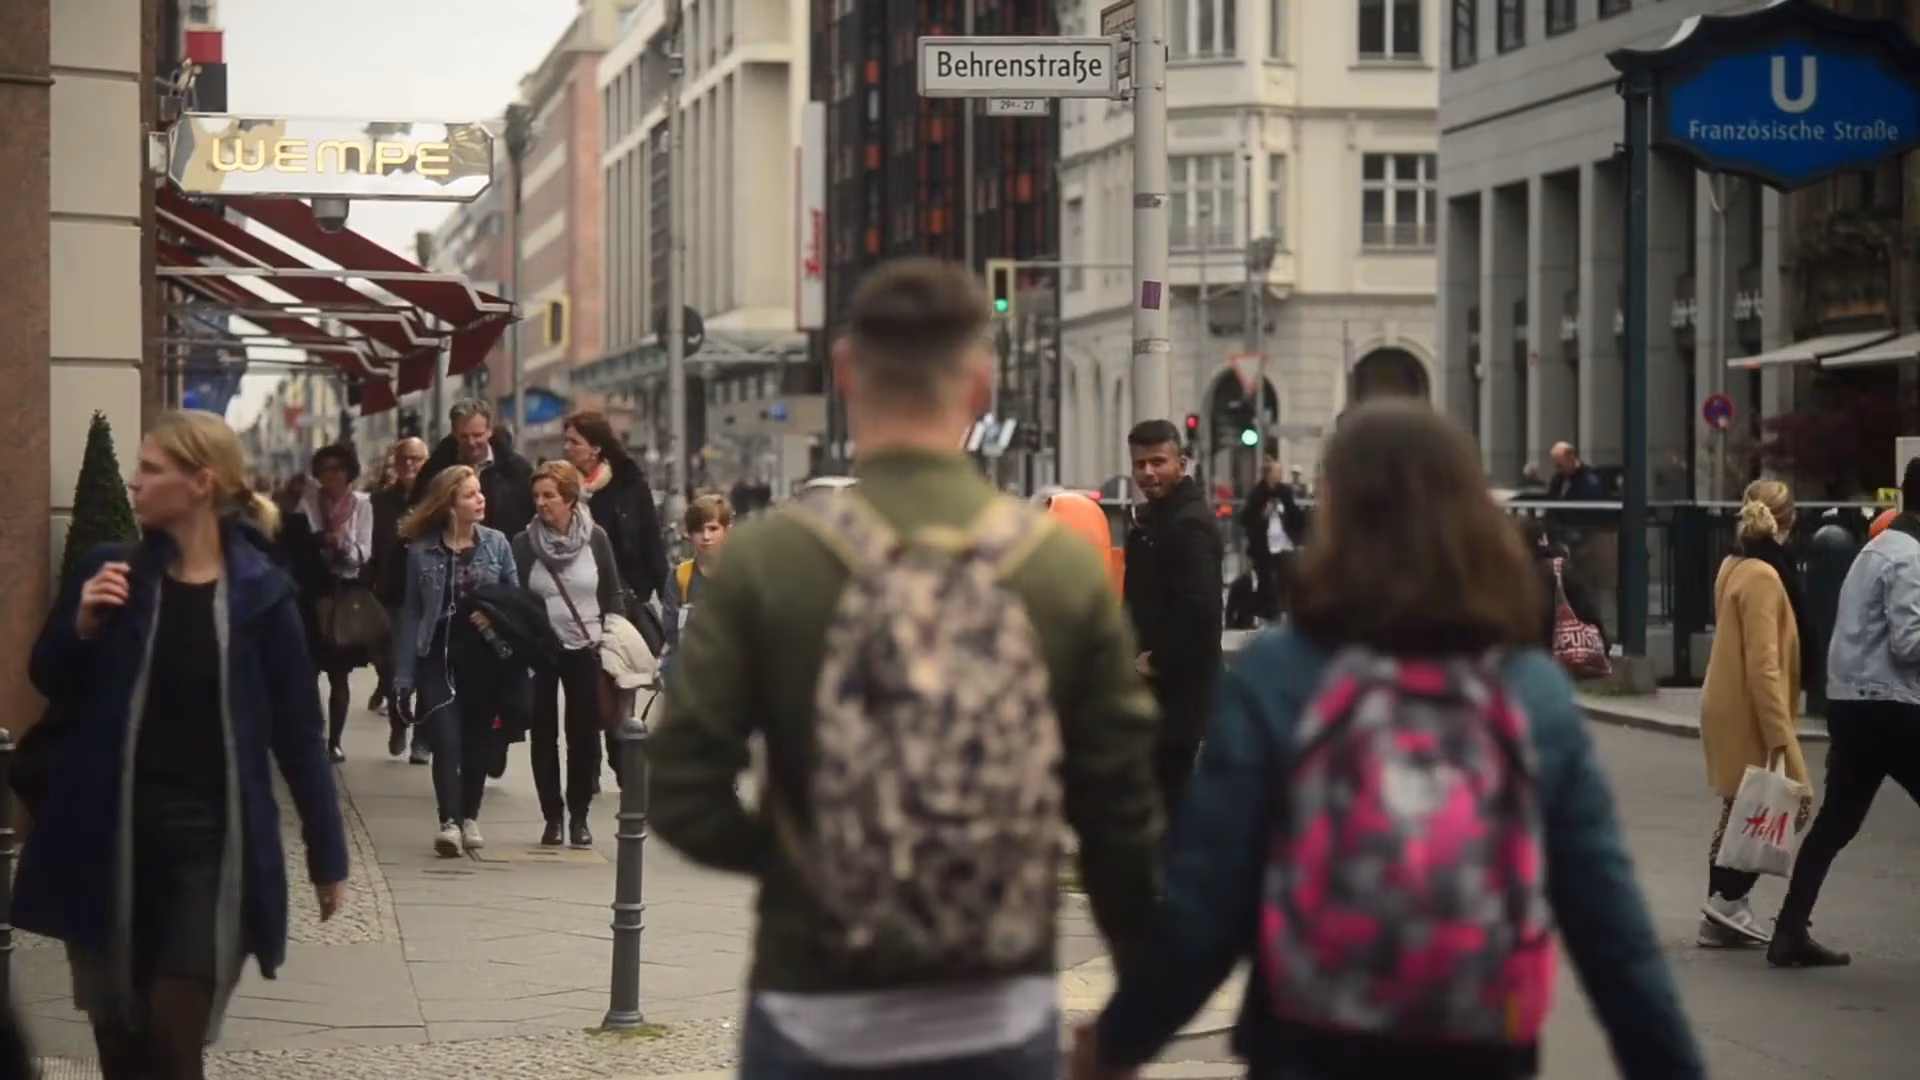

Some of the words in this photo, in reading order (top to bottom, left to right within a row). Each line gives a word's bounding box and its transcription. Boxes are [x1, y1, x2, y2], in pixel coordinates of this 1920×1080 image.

[937, 50, 1103, 84] Behrenstraße
[1770, 55, 1817, 113] U
[1689, 119, 1826, 141] Französische
[1833, 119, 1899, 141] Straße
[211, 137, 451, 176] WEMPE
